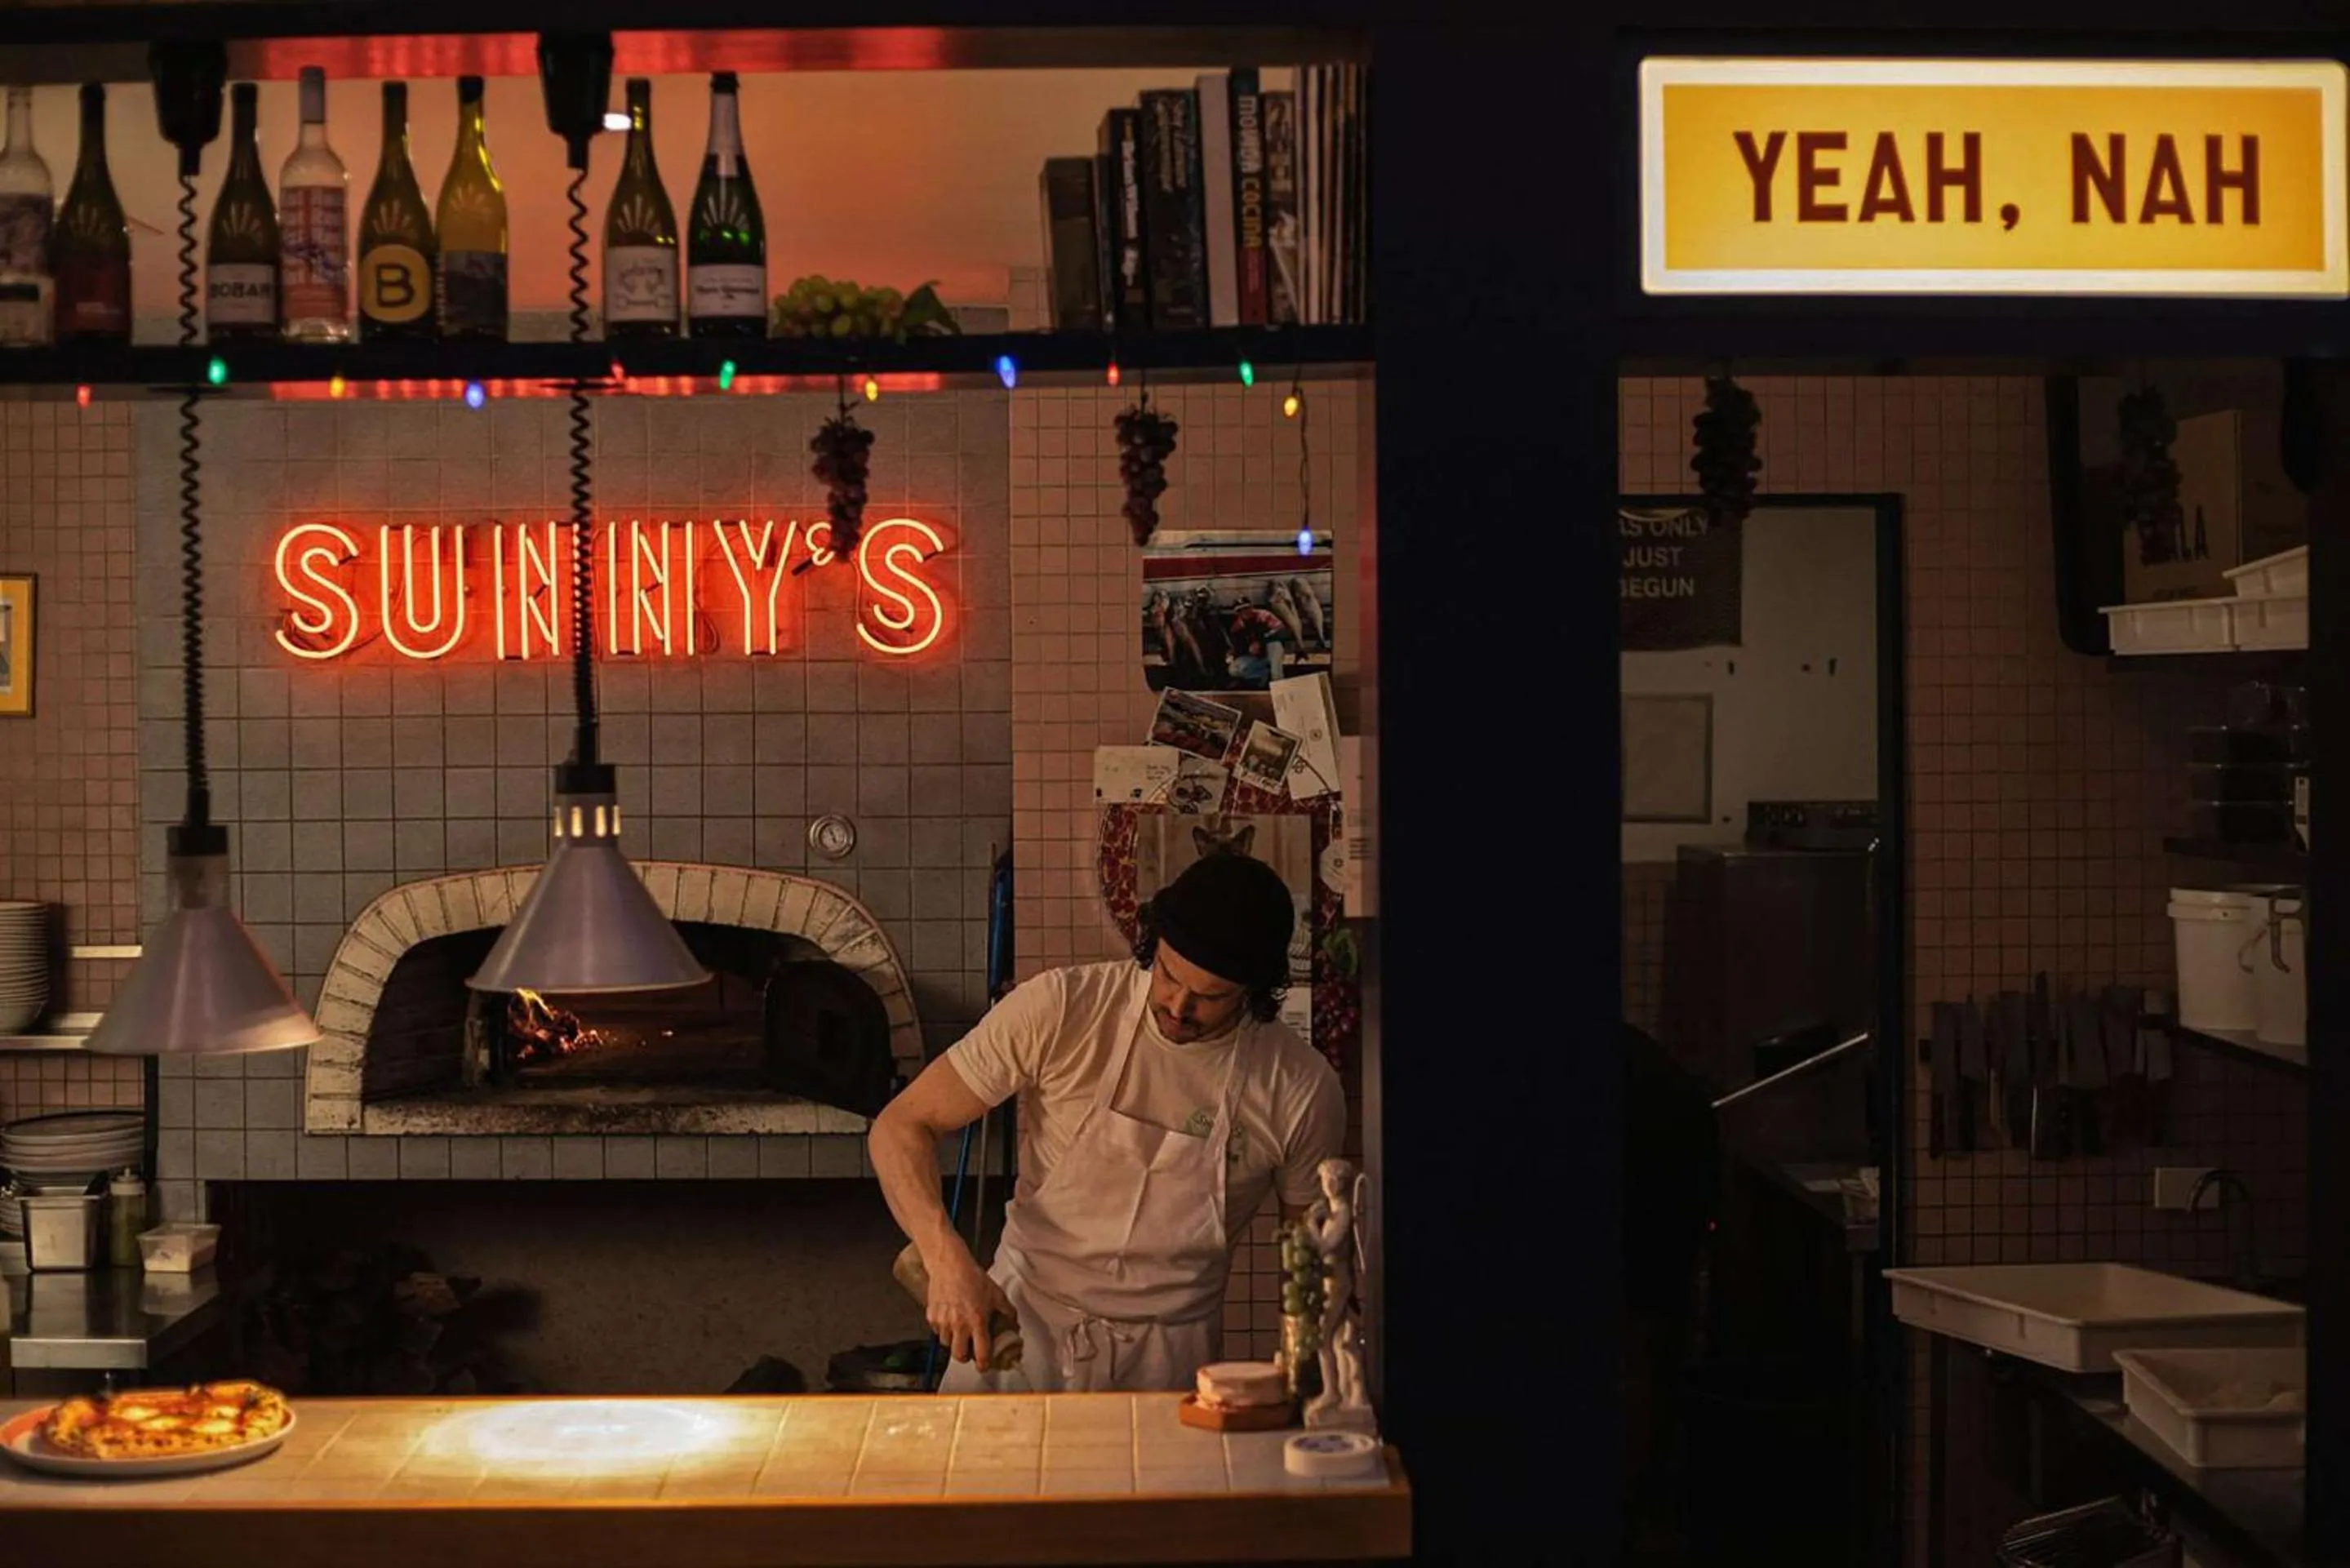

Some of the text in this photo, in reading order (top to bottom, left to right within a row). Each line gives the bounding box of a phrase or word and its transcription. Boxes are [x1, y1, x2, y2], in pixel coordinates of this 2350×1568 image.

[1734, 131, 2260, 231] YEAH, NAH
[376, 263, 415, 308] B
[1649, 515, 1709, 538] ONLY
[1623, 545, 1684, 568] JUST
[275, 518, 944, 659] SUNNY'S
